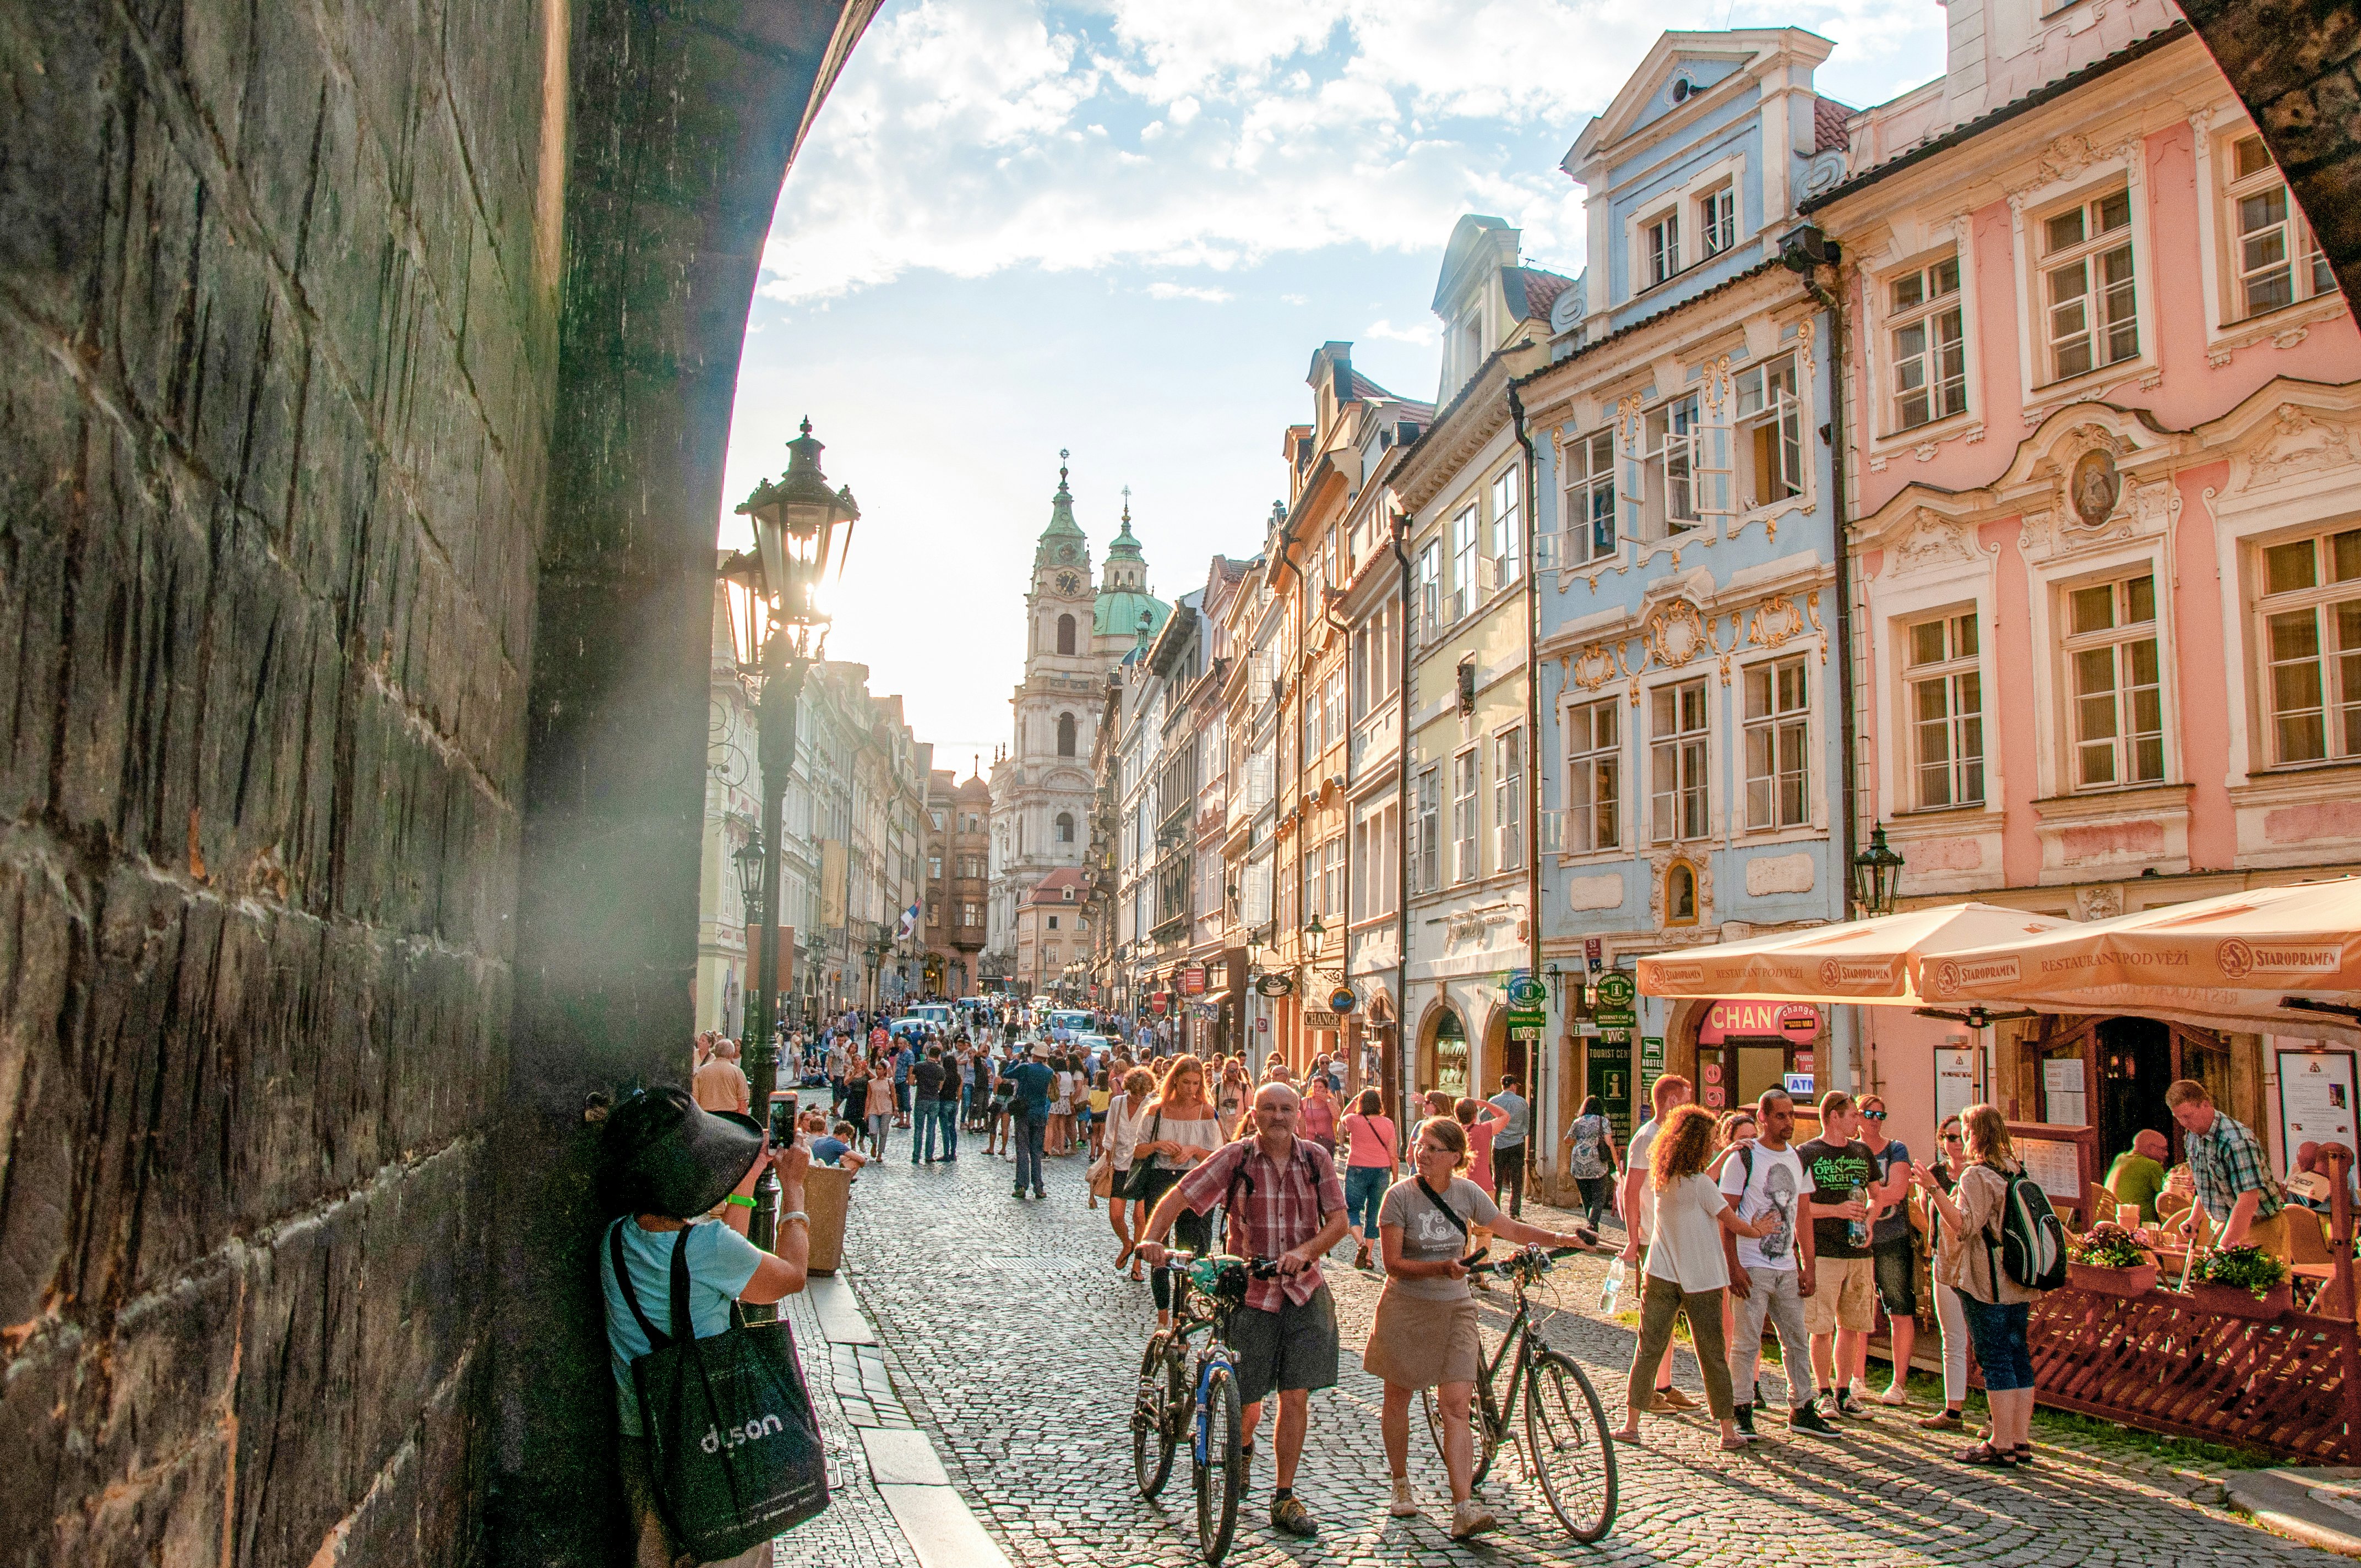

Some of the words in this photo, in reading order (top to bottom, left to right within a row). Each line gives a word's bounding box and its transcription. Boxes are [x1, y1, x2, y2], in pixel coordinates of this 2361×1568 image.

[2041, 951, 2120, 973] RESTAURANT
[2121, 952, 2153, 965] POD
[1715, 967, 1761, 979] RESTAURANT
[1762, 967, 1783, 978] POD
[1512, 978, 1530, 988] TOURIST
[1531, 979, 1542, 989] INFO
[1600, 976, 1619, 986] TOURIST
[1620, 976, 1631, 987] INFO
[1782, 1005, 1814, 1017] change
[1305, 1014, 1339, 1025] CHANGE
[1711, 1006, 1784, 1029] CHAN
[1519, 1028, 1536, 1039] WC
[1607, 1031, 1625, 1042] WC
[1590, 1049, 1614, 1058] TOURIST
[1642, 1059, 1663, 1068] HOSTEL
[1813, 1156, 1832, 1167] Los
[1834, 1155, 1866, 1166] Angeles
[1814, 1165, 1843, 1175] OPEN
[1823, 1174, 1854, 1183] NIGHT
